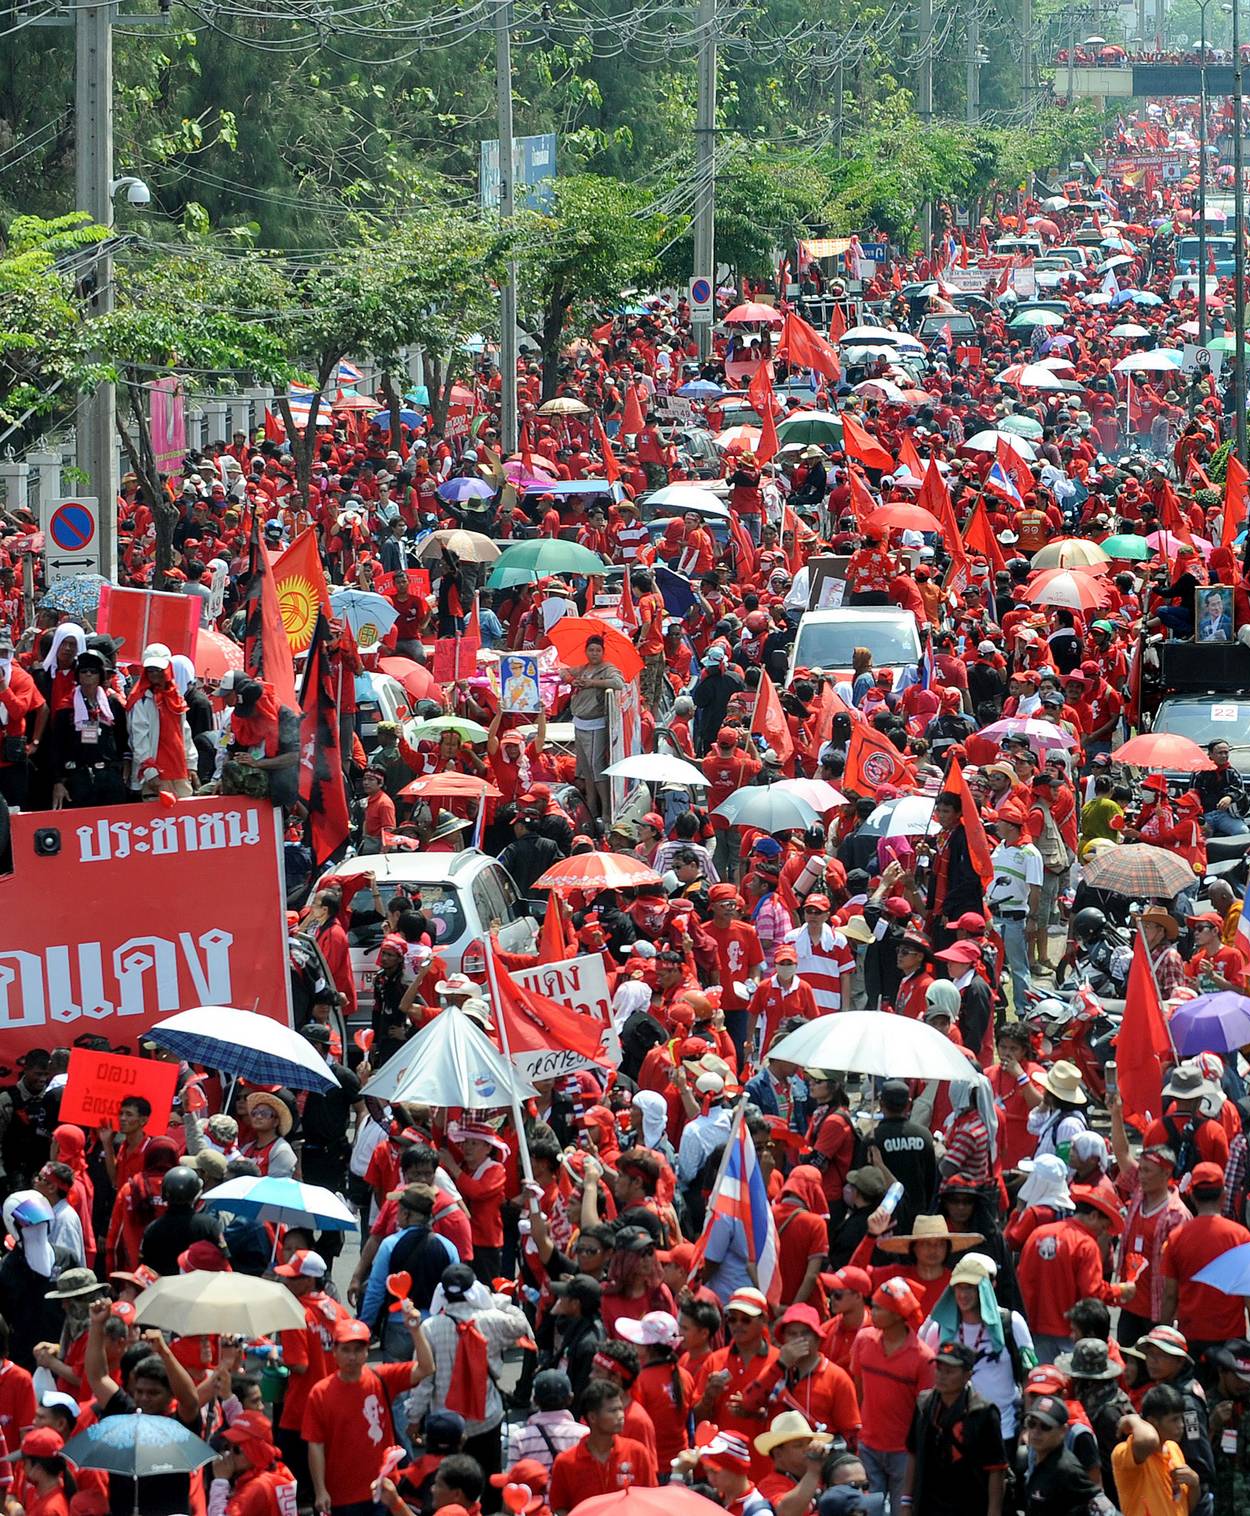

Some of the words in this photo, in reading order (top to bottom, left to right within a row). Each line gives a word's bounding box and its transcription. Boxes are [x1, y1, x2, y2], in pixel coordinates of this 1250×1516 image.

[1214, 708, 1235, 718] 22
[76, 808, 261, 863] ประชาชน
[883, 1136, 925, 1153] GUARD
